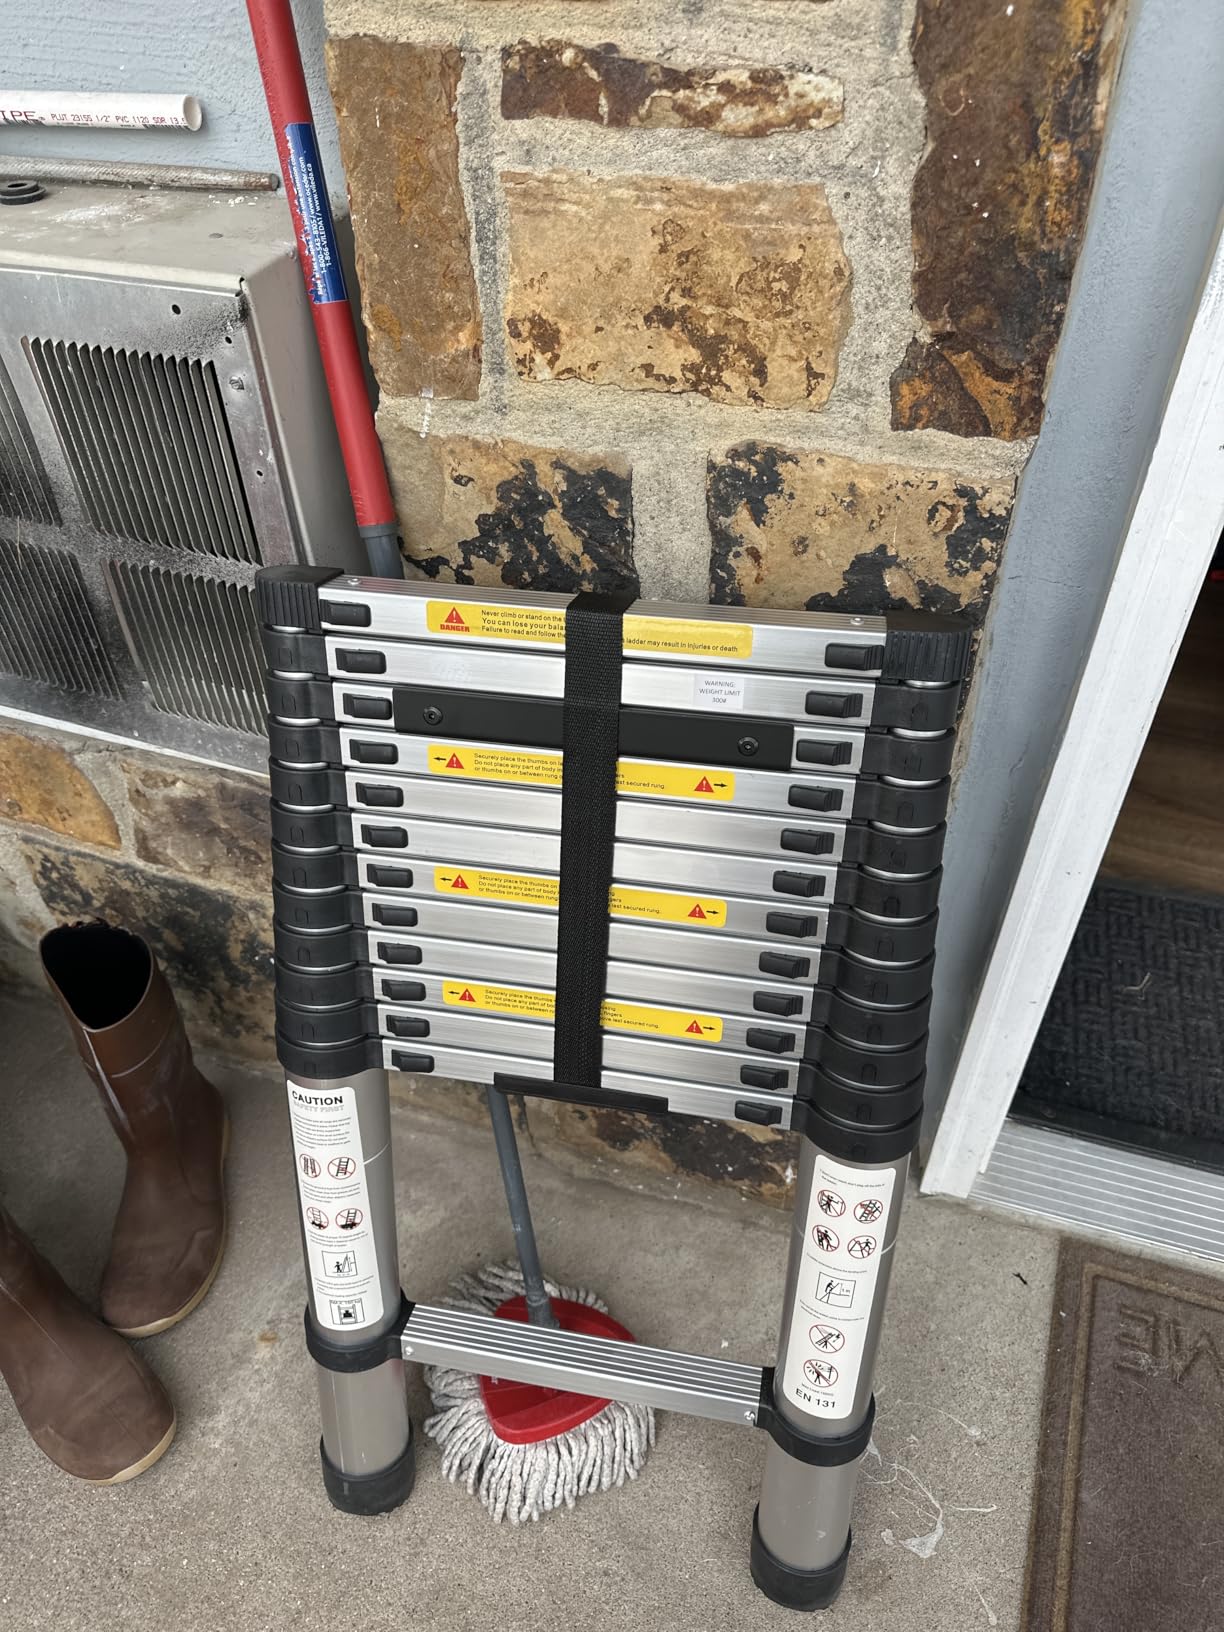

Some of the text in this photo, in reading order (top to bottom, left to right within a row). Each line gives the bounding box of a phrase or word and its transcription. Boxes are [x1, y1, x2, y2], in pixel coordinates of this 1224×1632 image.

[152, 116, 166, 124] SDR
[440, 624, 470, 632] DANGER
[530, 622, 547, 630] your
[548, 622, 566, 631] bala
[688, 642, 711, 650] injuries
[292, 1090, 342, 1106] CAUTION
[796, 1388, 812, 1402] EN
[816, 1398, 836, 1408] 131
